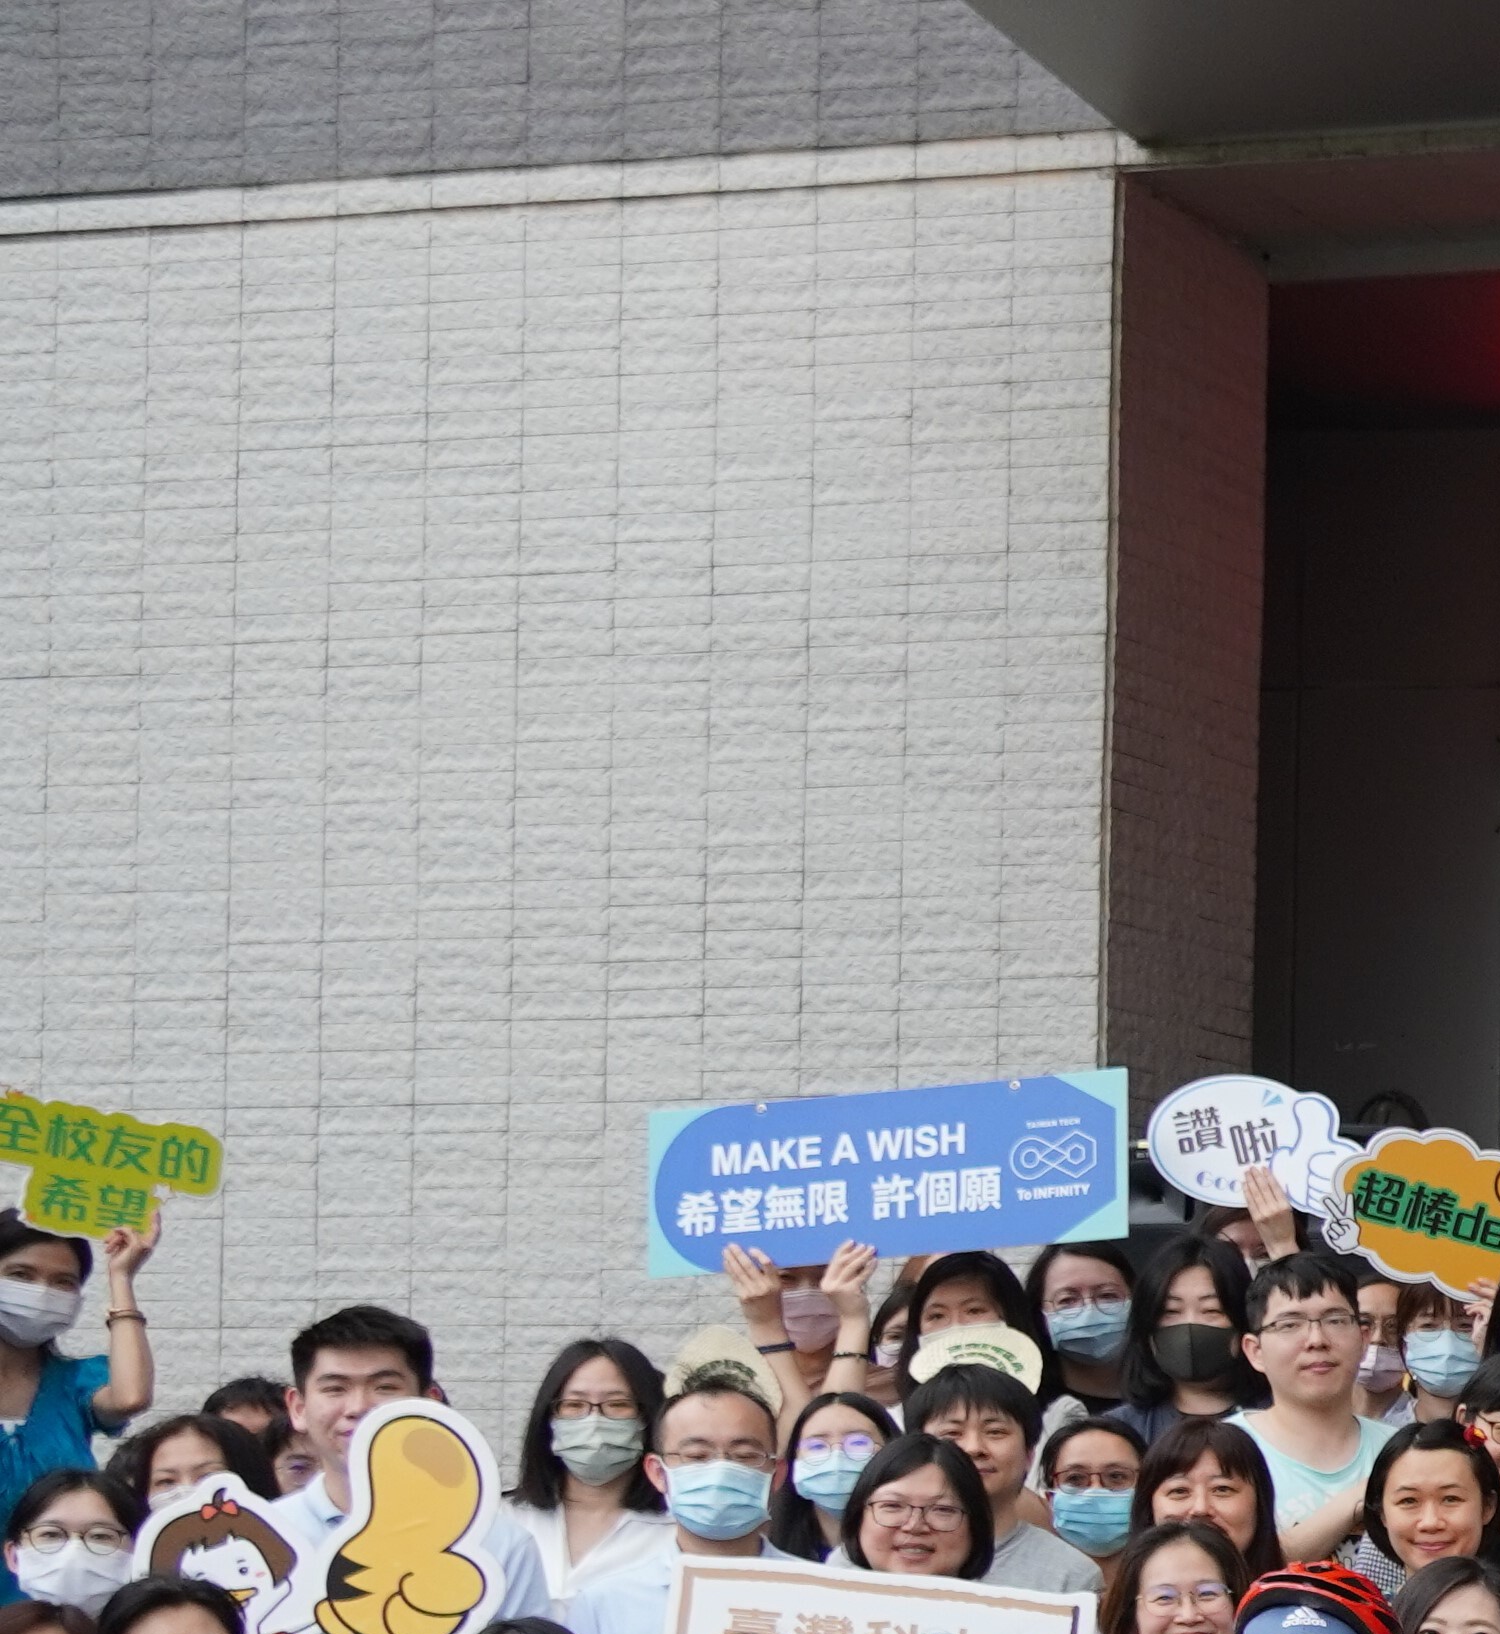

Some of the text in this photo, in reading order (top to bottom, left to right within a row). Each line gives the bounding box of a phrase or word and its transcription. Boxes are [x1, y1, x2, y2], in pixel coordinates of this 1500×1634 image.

[711, 1123, 966, 1177] MAKE A WISH
[1172, 1106, 1278, 1166] 讚啦
[40, 1174, 150, 1232] 希望
[676, 1165, 1002, 1238] 希望無限 許個願
[1017, 1183, 1090, 1201] To INFINITY
[1282, 1617, 1328, 1629] adidas
